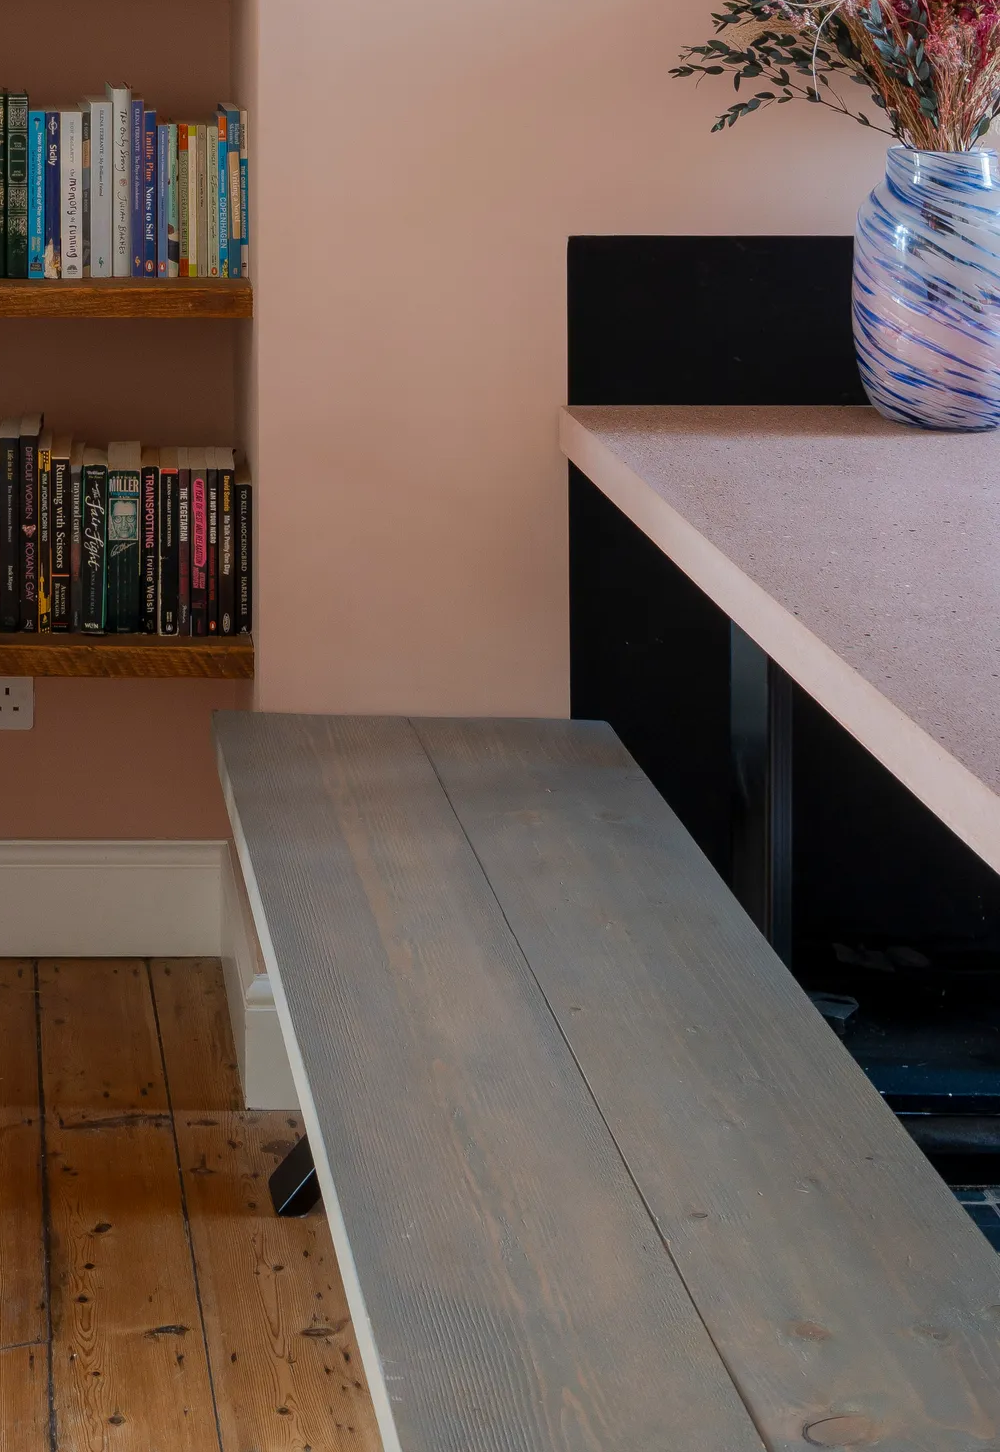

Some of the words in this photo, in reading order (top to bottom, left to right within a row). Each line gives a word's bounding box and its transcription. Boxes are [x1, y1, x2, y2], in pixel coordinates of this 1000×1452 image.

[48, 145, 57, 166] Sicily
[67, 177, 77, 215] memory
[146, 213, 153, 221] to
[146, 224, 154, 241] Self
[67, 225, 77, 258] running
[25, 447, 33, 482] DIFFICULT
[54, 464, 65, 505] Running
[56, 507, 65, 528] with
[146, 474, 154, 548] TRAINSPOTTING
[26, 542, 34, 580] ROXANE
[56, 532, 66, 568] Scissors
[146, 555, 154, 581] Irvine
[26, 582, 34, 601] GAY
